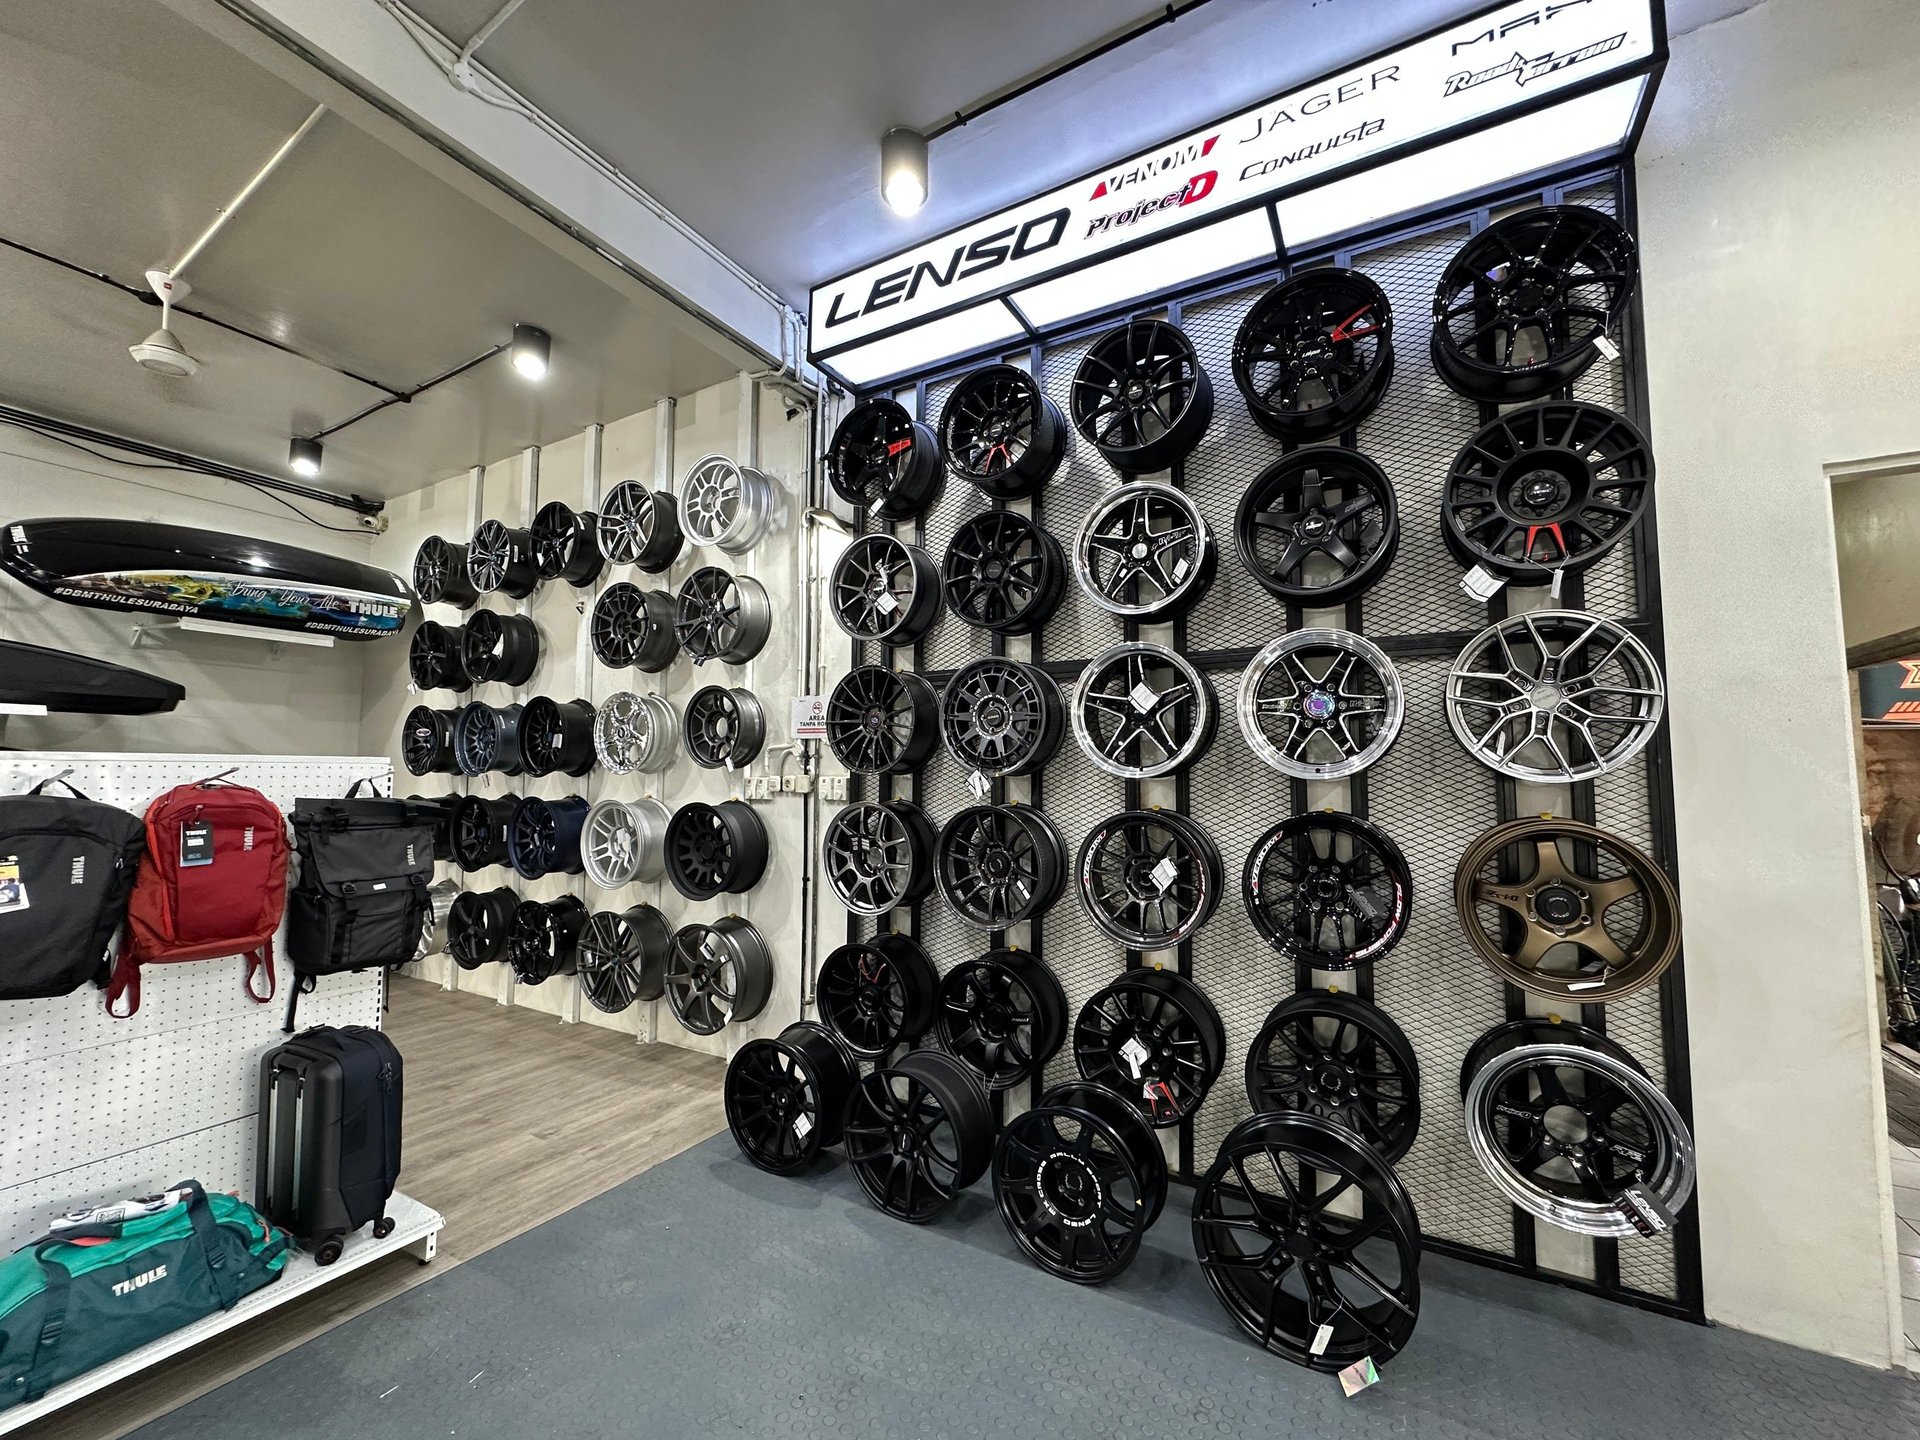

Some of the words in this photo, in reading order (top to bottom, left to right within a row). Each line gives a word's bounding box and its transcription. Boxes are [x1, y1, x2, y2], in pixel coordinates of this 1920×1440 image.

[1104, 140, 1206, 194] VENOM
[824, 207, 1072, 329] LENSO
[53, 586, 200, 614] #DBMTHULESURABAYA
[229, 581, 268, 602] Bring
[271, 587, 311, 607] Your
[349, 600, 399, 618] THULE
[243, 826, 255, 851] THULE
[71, 856, 85, 885] THULE
[1252, 835, 1280, 886] VENOM
[1050, 1152, 1085, 1165] RALLY
[1630, 1190, 1667, 1228] LENSO
[111, 1265, 167, 1297] THULE
